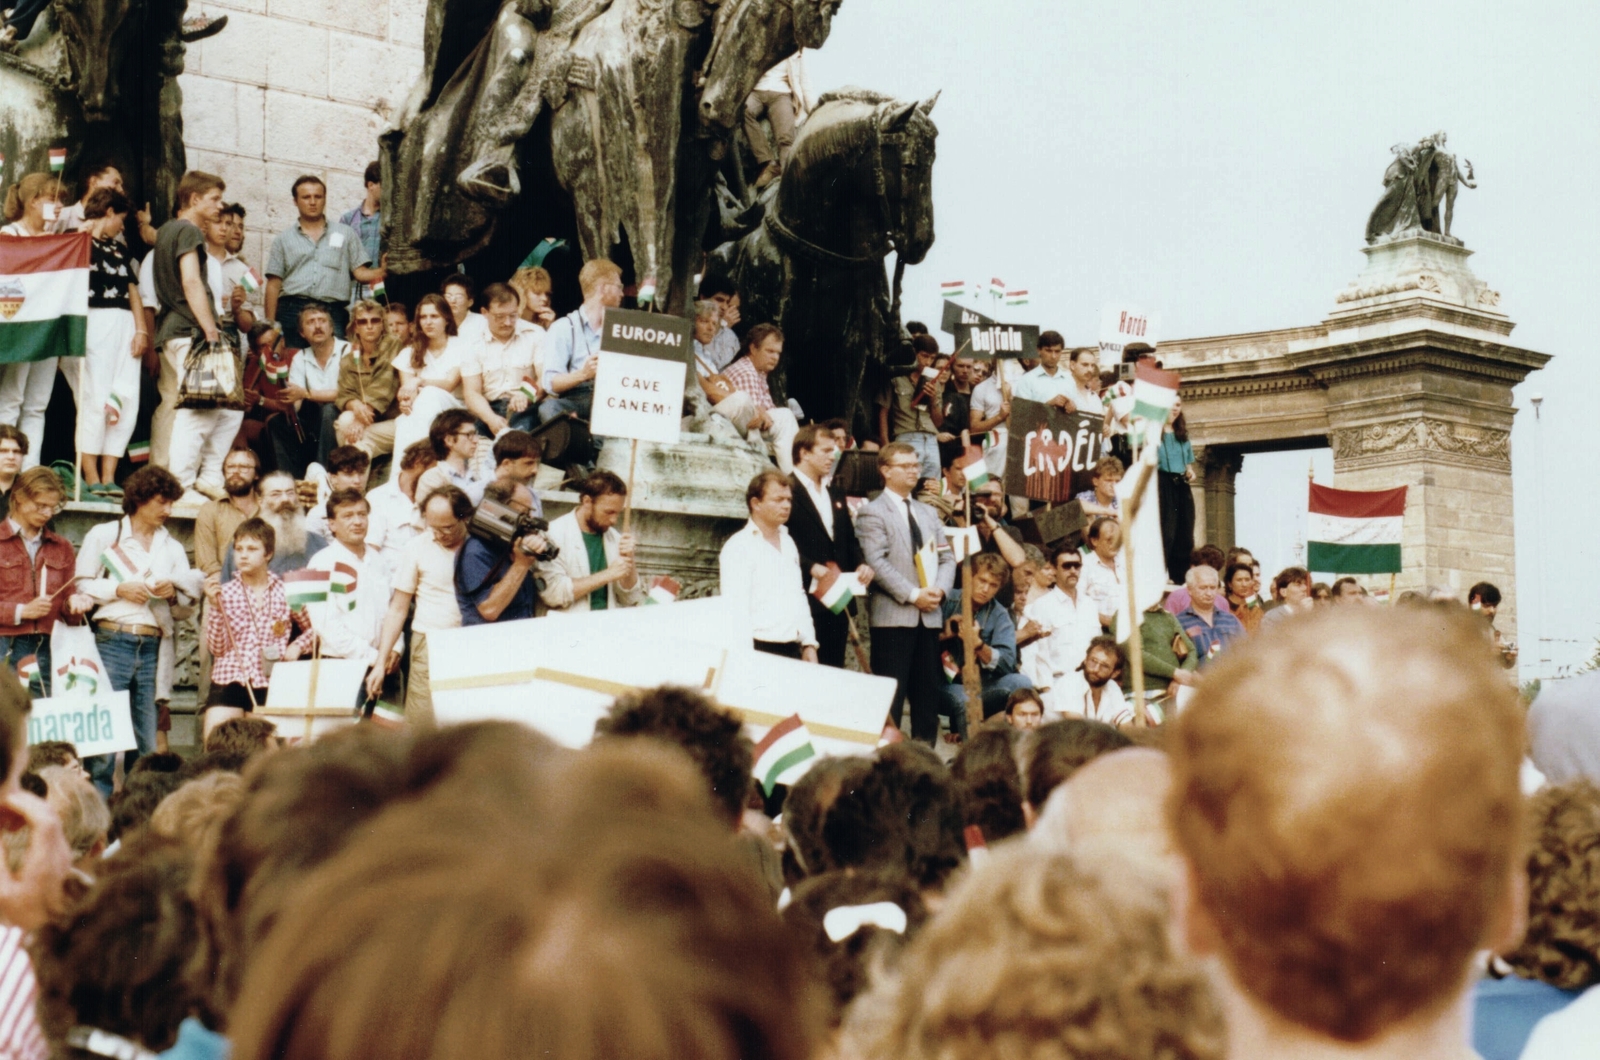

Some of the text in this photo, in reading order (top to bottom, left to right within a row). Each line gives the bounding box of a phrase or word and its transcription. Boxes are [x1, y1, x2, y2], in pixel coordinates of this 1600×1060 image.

[612, 323, 682, 347] EUROPA!
[621, 376, 660, 392] CAVE
[607, 397, 671, 415] CANEM!
[1023, 420, 1102, 476] ERDÉL
